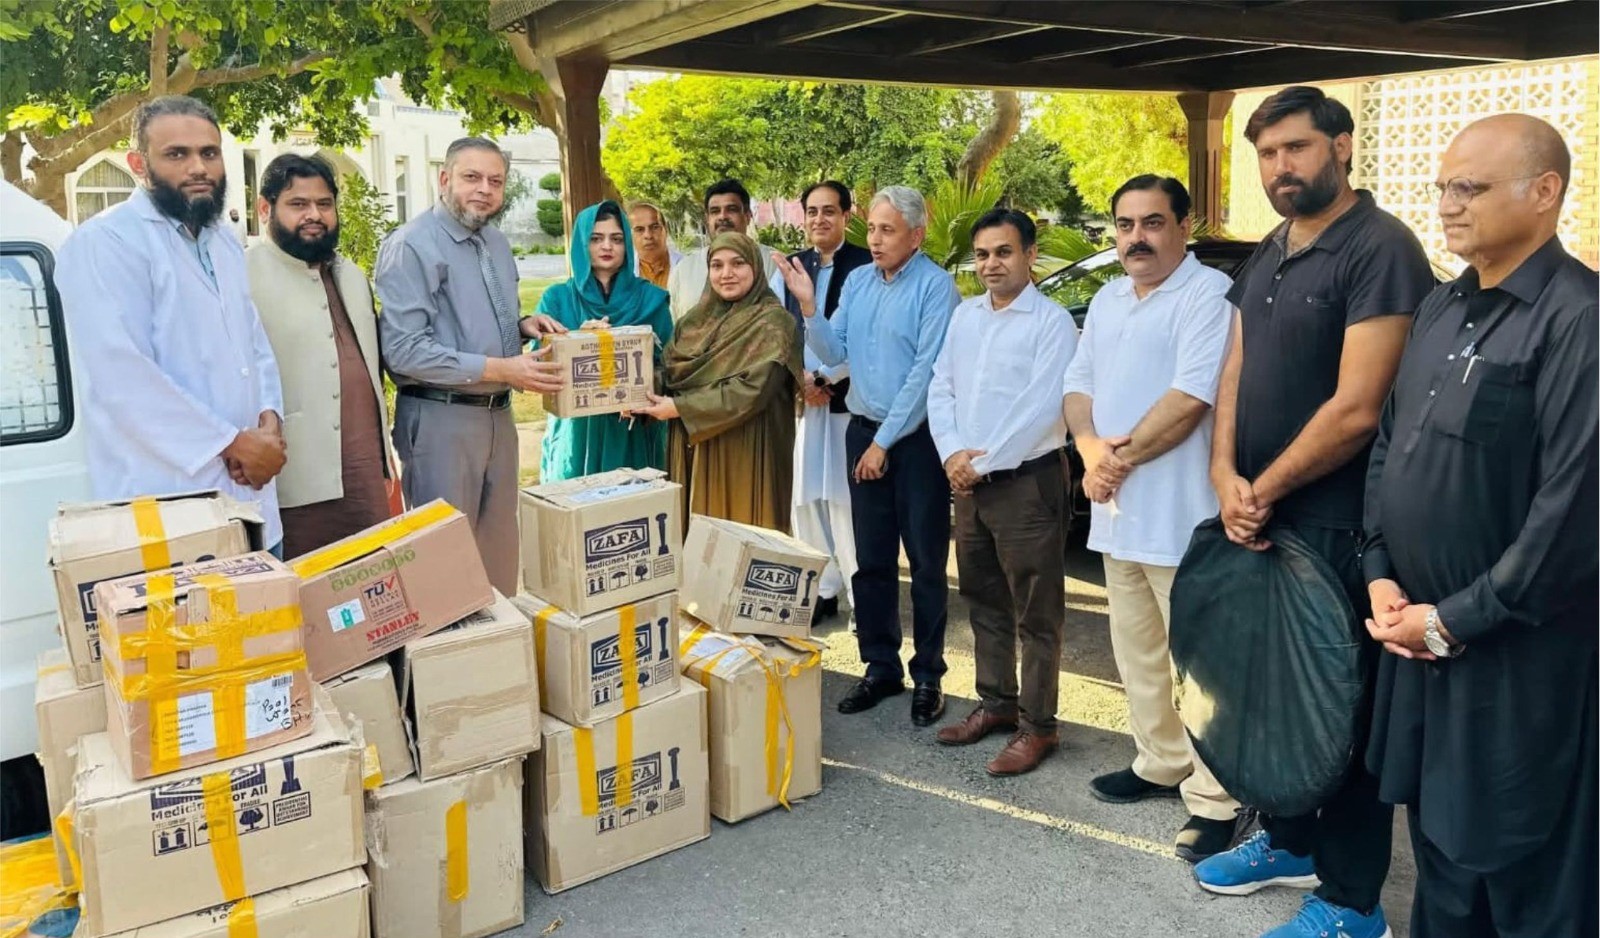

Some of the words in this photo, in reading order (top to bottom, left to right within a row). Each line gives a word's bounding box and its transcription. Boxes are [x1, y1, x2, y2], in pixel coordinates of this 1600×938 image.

[580, 361, 621, 374] ZAA
[593, 529, 641, 551] ZAFA
[586, 556, 626, 572] Medicines
[626, 553, 640, 561] For
[642, 549, 651, 557] All
[754, 568, 792, 585] ZAFA
[742, 588, 776, 600] Medicines
[776, 594, 788, 602] For
[600, 636, 644, 661] ZAA
[591, 667, 624, 683] Medicin
[605, 765, 654, 790] ZAFA
[638, 788, 650, 797] For
[151, 798, 212, 821] Medicin
[227, 789, 247, 803] or
[250, 784, 268, 798] All
